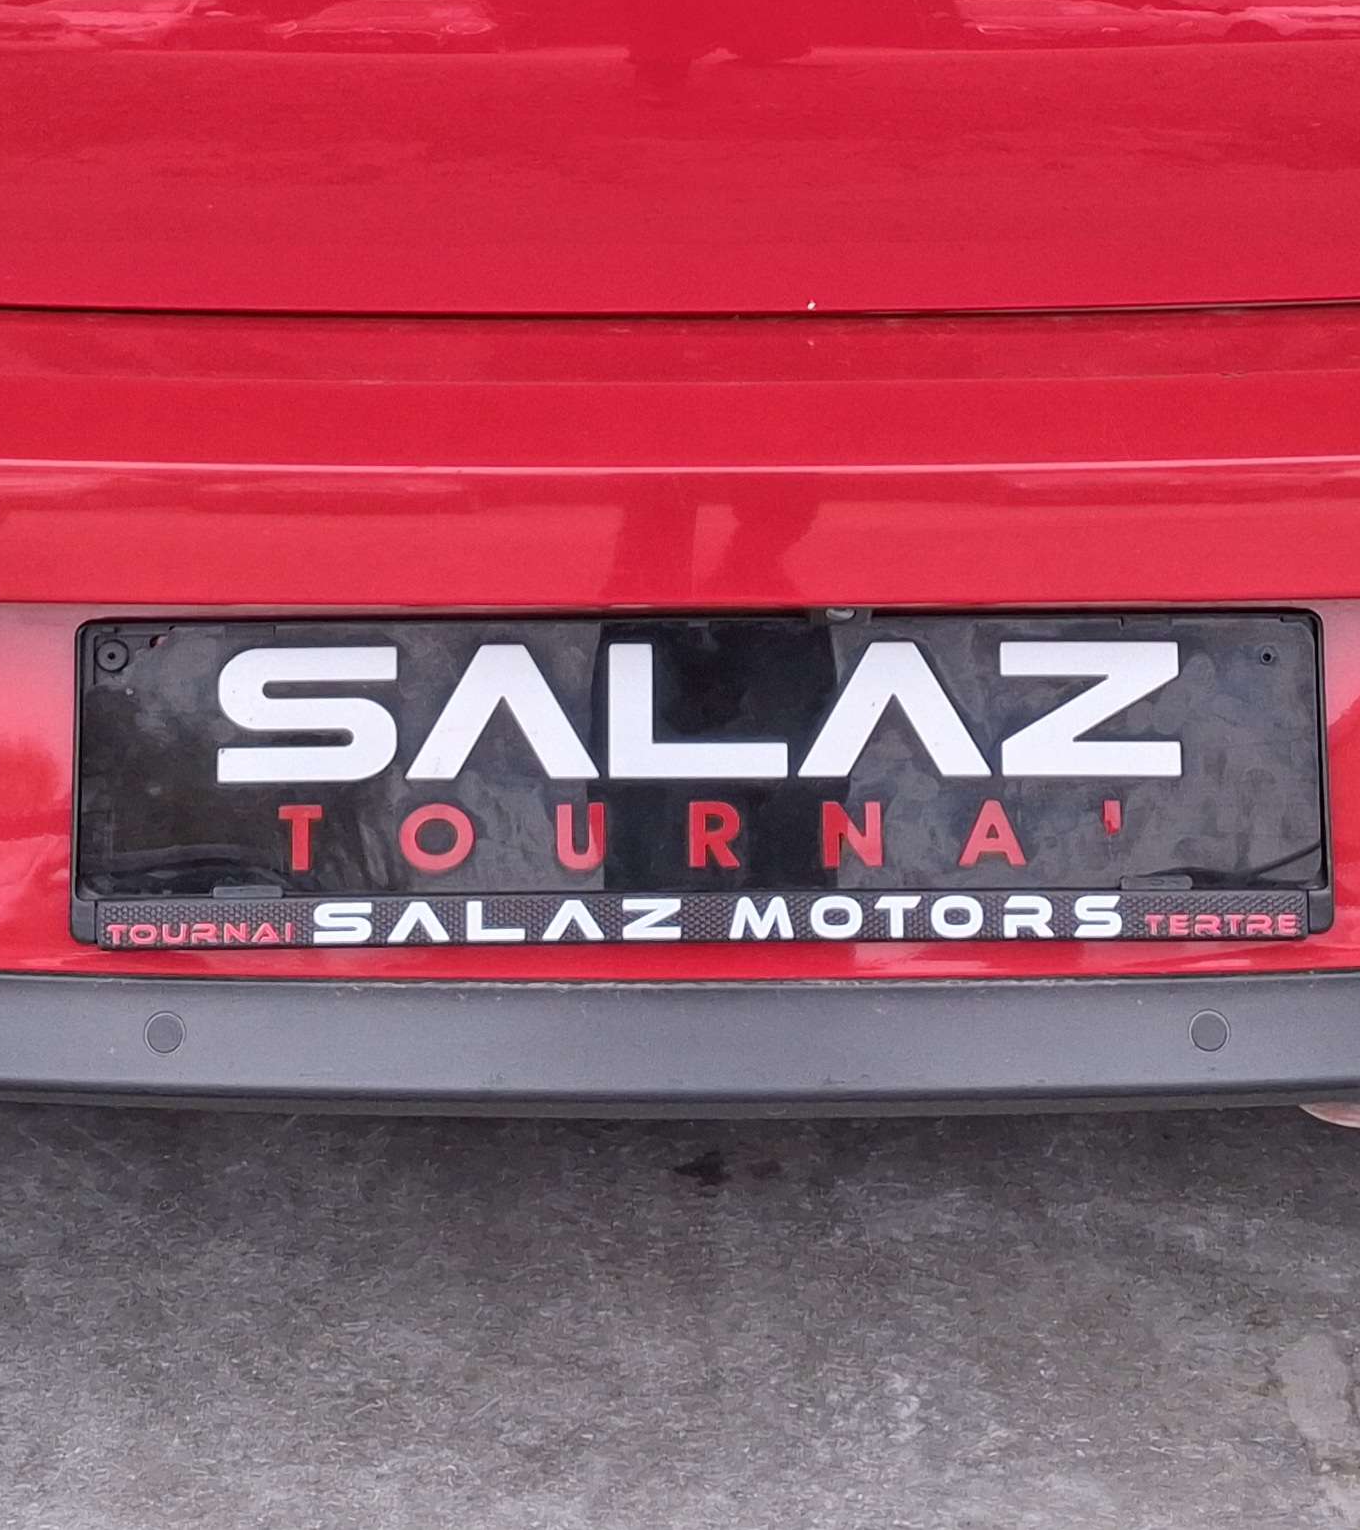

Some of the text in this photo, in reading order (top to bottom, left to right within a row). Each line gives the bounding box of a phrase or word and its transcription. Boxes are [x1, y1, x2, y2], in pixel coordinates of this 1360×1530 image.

[215, 640, 1183, 784] SALAZ
[105, 893, 1302, 946] TOURNAI SALAZ MOTORS TERTRE
